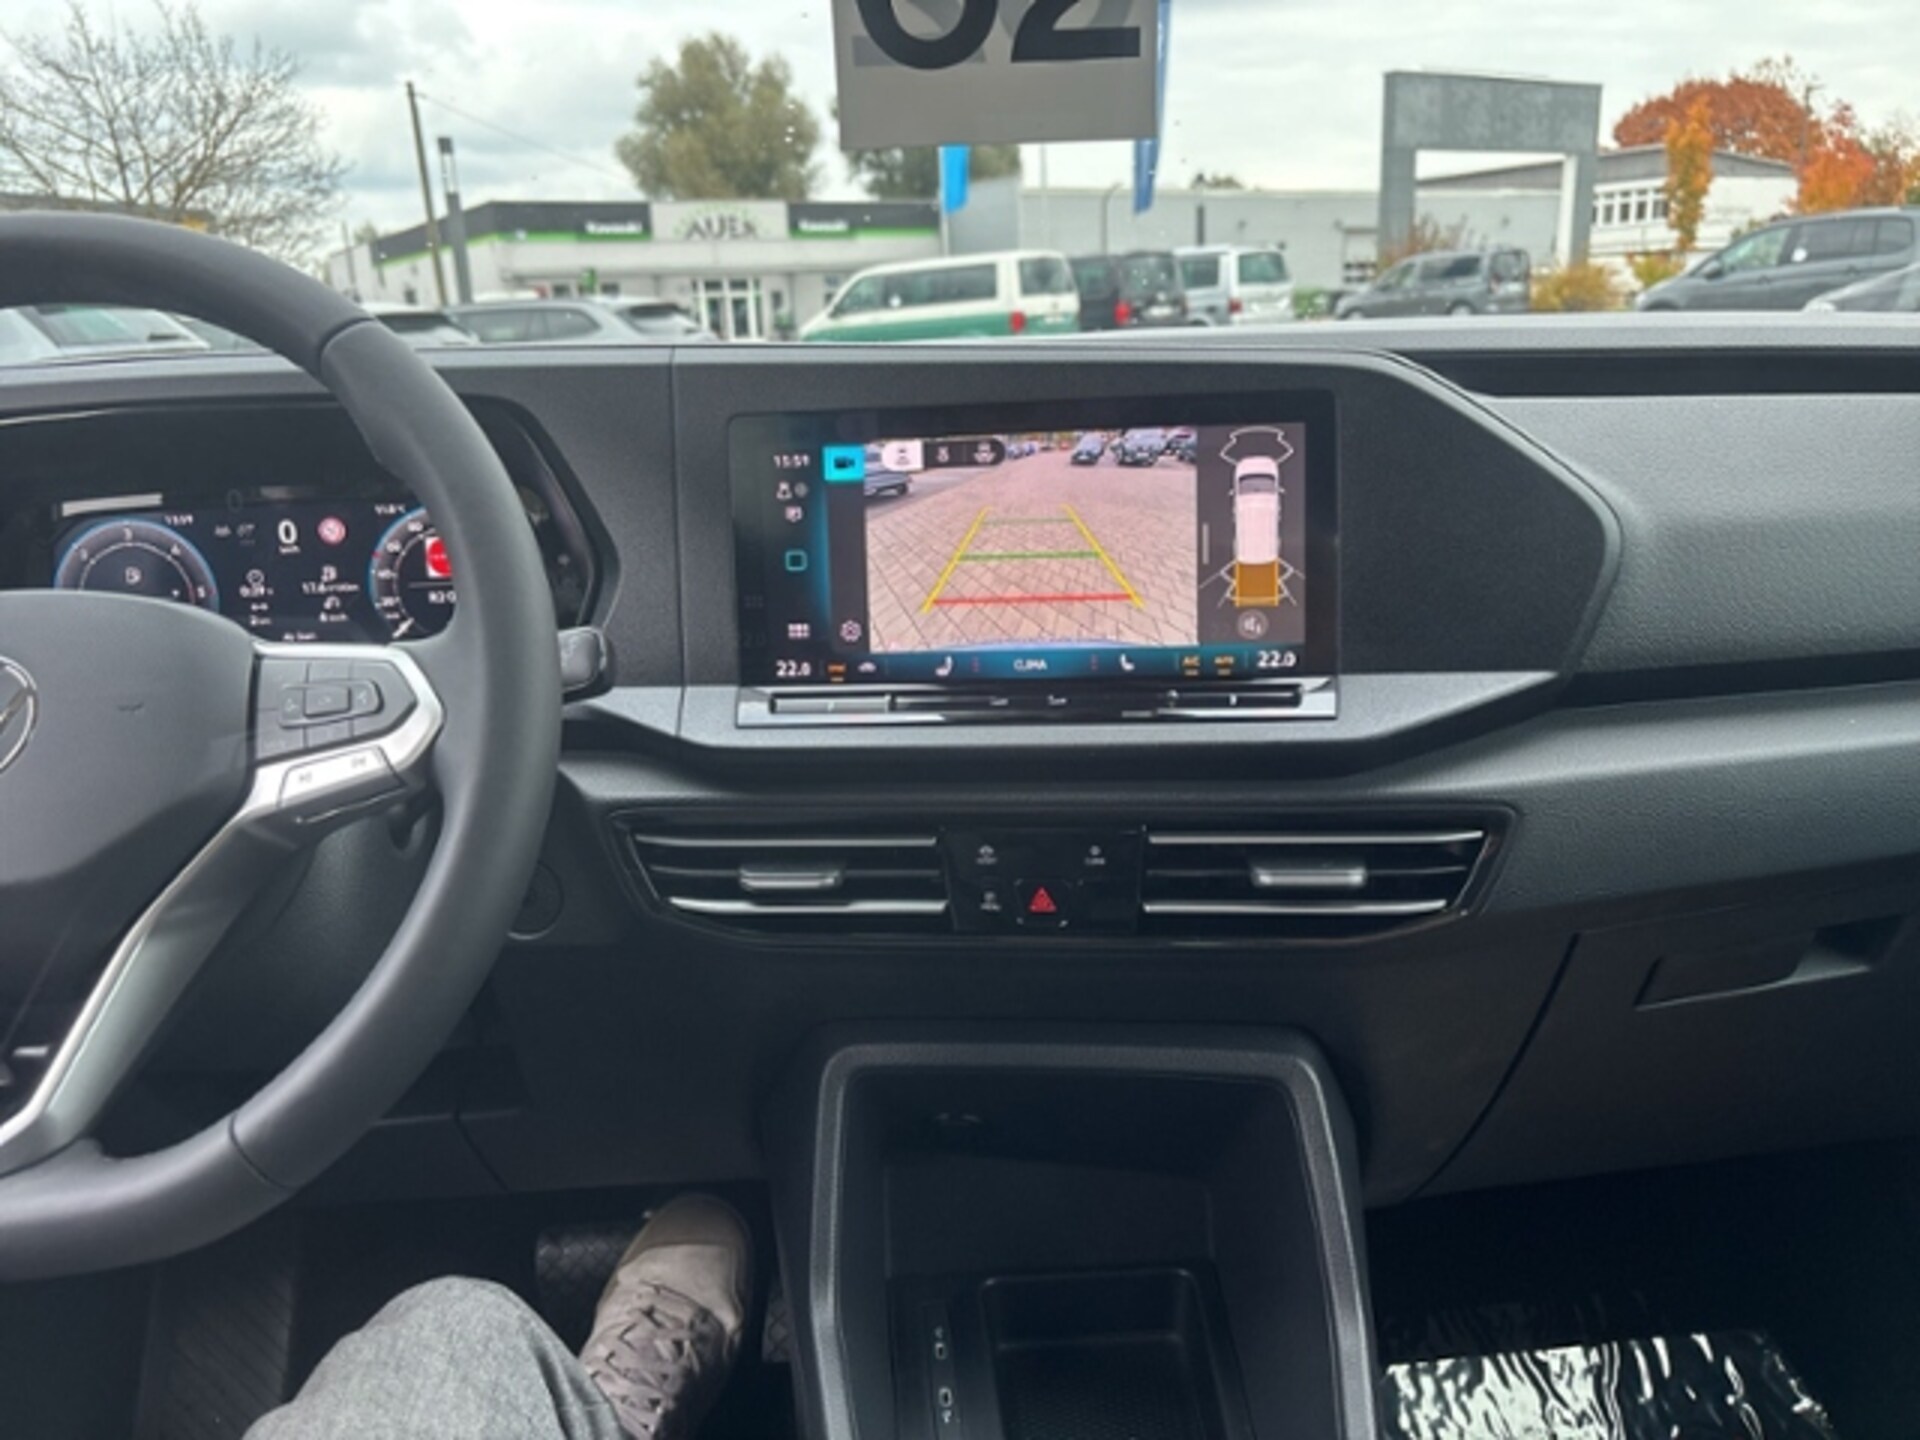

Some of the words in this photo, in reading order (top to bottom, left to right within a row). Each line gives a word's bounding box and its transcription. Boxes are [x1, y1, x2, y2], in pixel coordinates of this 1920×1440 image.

[276, 518, 299, 545] 0
[775, 658, 812, 678] 22.0
[1255, 650, 1297, 669] 22.0
